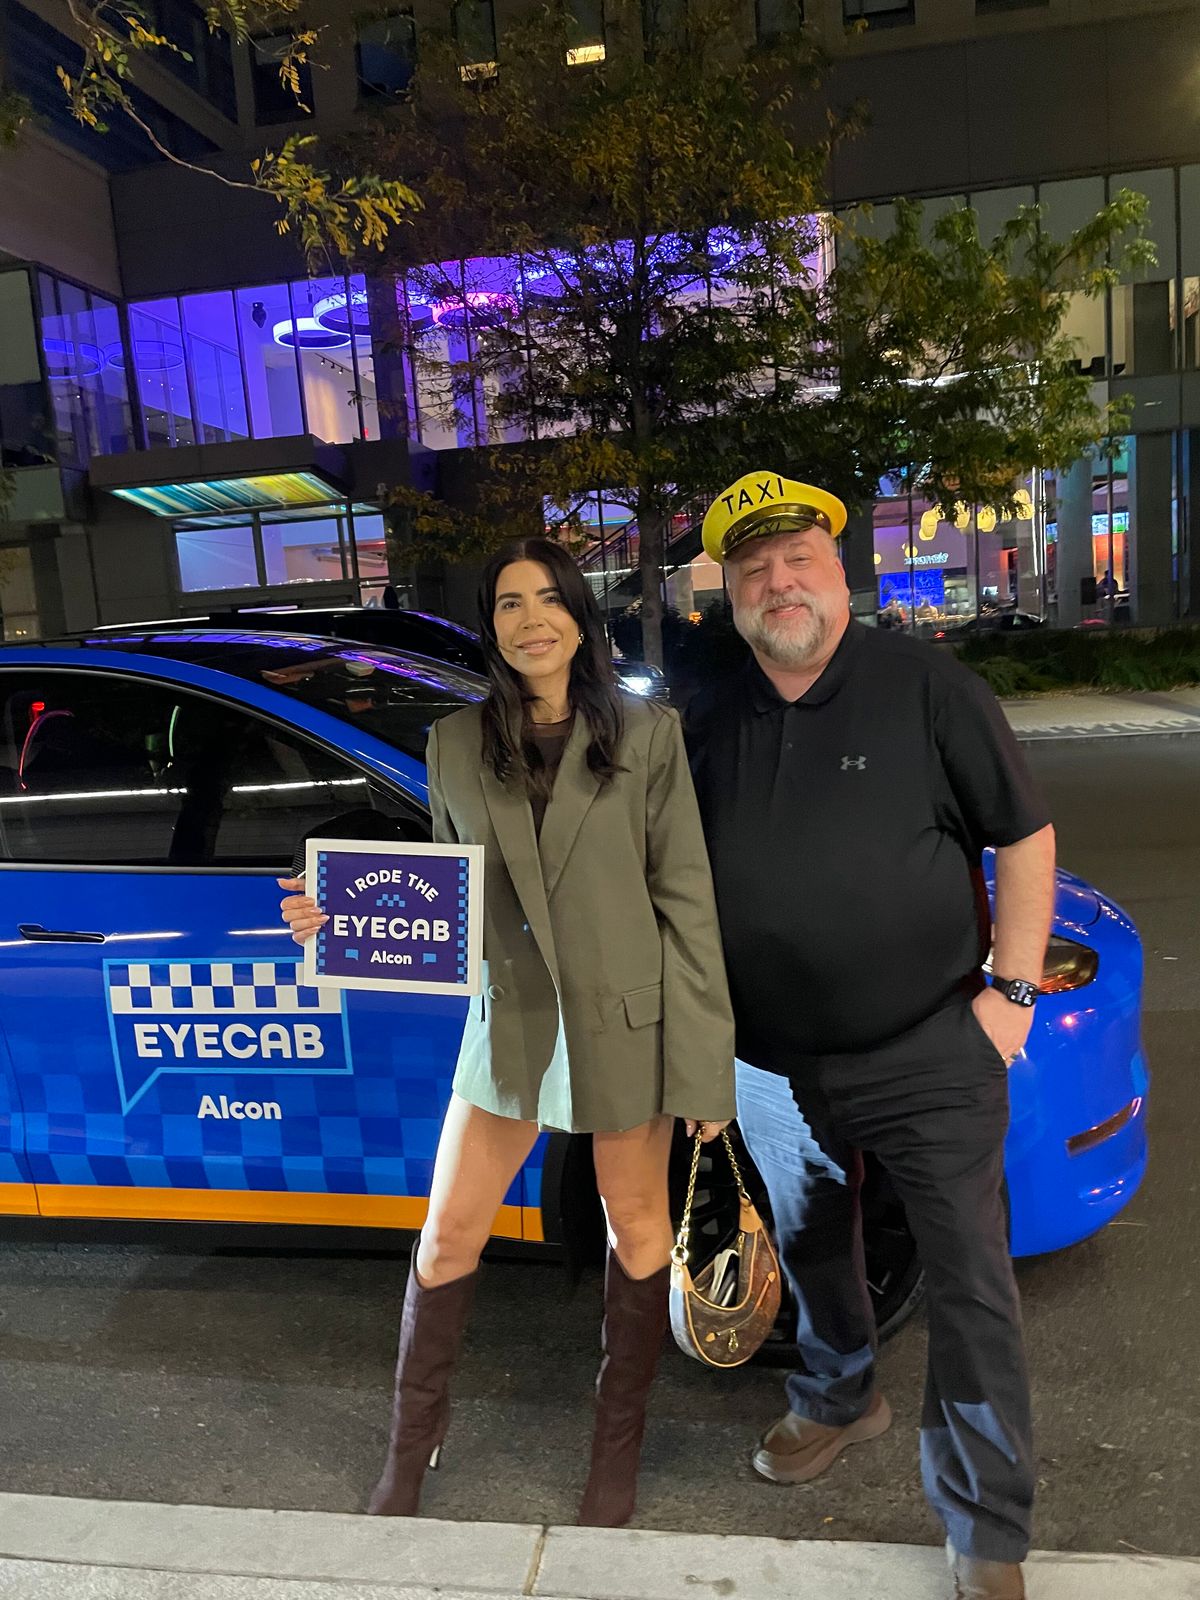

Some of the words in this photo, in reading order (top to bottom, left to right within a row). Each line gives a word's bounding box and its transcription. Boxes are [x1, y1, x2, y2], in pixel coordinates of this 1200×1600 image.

[721, 477, 785, 515] TAXI
[345, 887, 357, 899] I
[354, 869, 403, 893] RODE
[408, 873, 440, 903] THE
[333, 914, 451, 942] EYECAB
[370, 950, 412, 965] Alcon
[133, 1023, 325, 1059] EYECAB
[197, 1095, 283, 1120] Alcon
